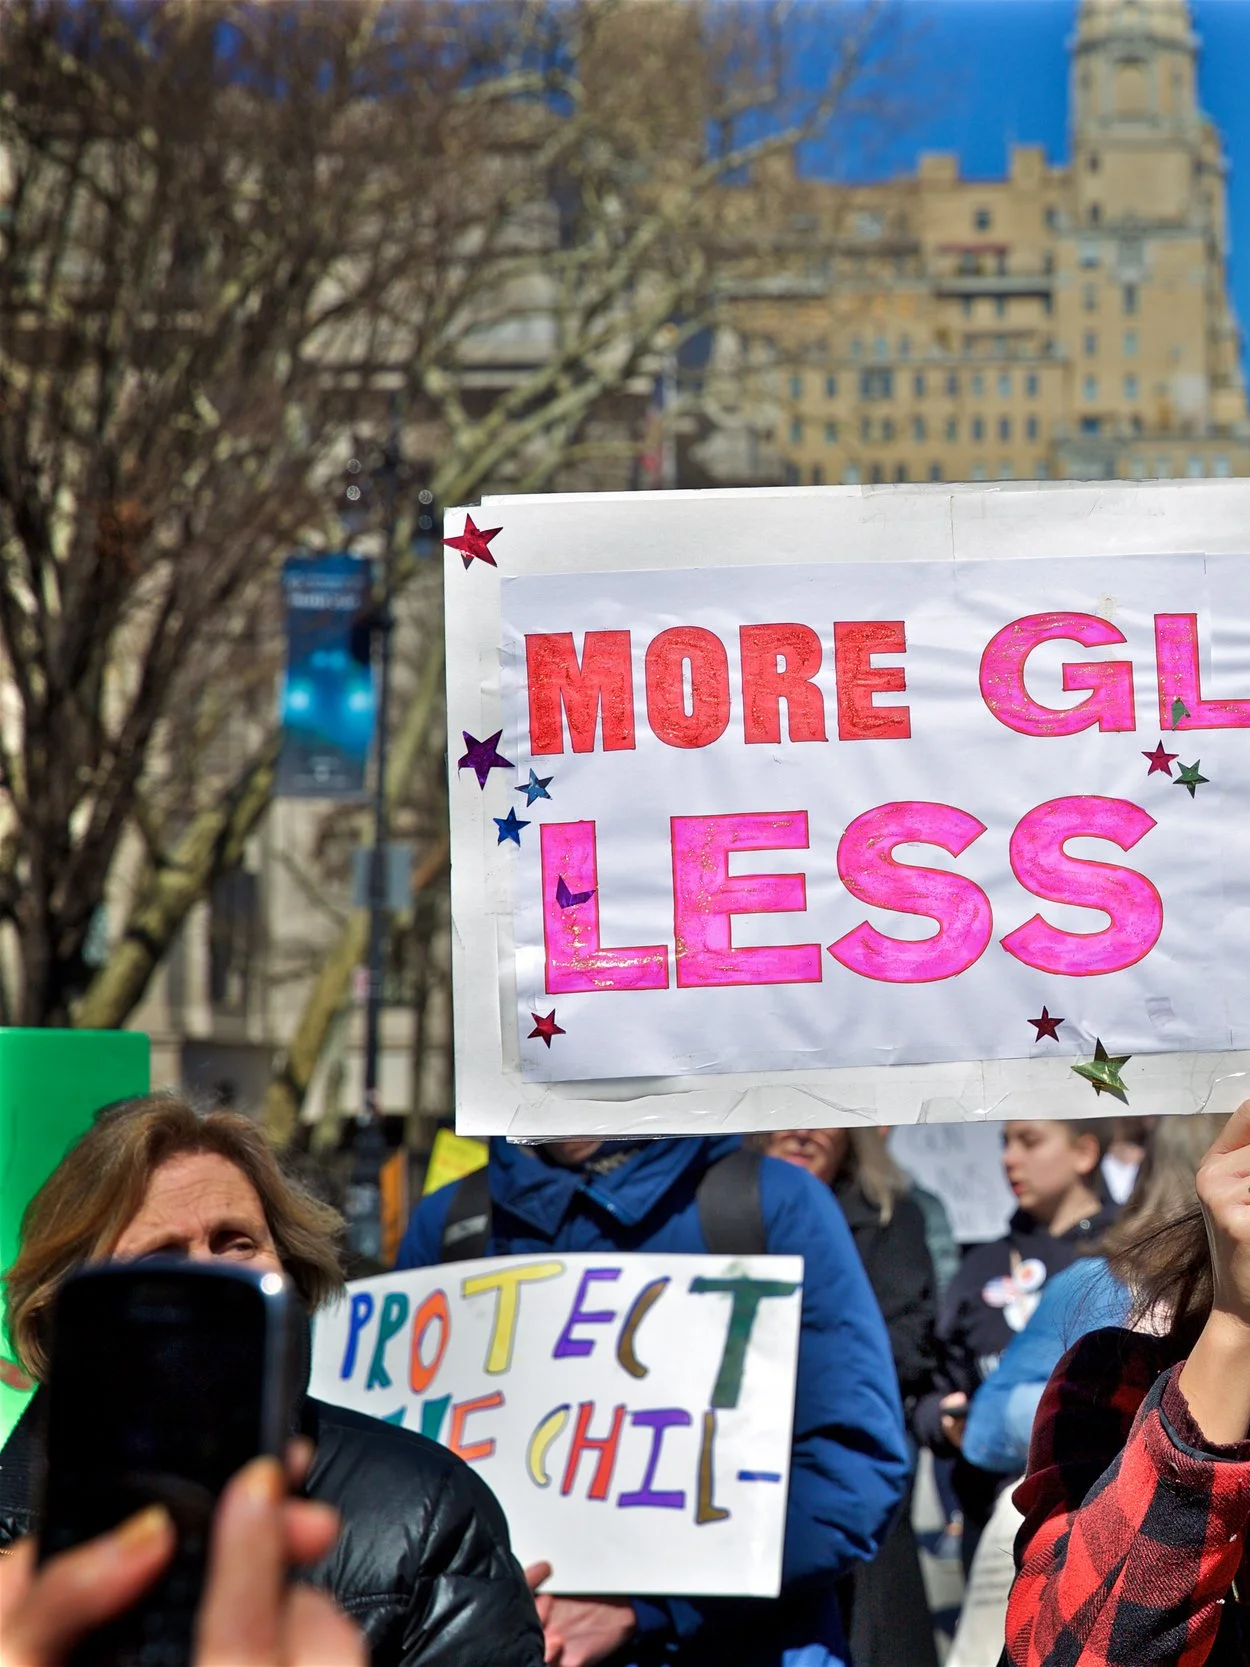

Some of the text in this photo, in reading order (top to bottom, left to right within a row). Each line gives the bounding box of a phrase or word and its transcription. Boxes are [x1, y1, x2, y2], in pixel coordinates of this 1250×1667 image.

[525, 620, 911, 756] MORE
[540, 795, 1163, 995] LESS
[340, 1261, 802, 1409] PROTECT
[526, 1400, 782, 1526] CHIL-
